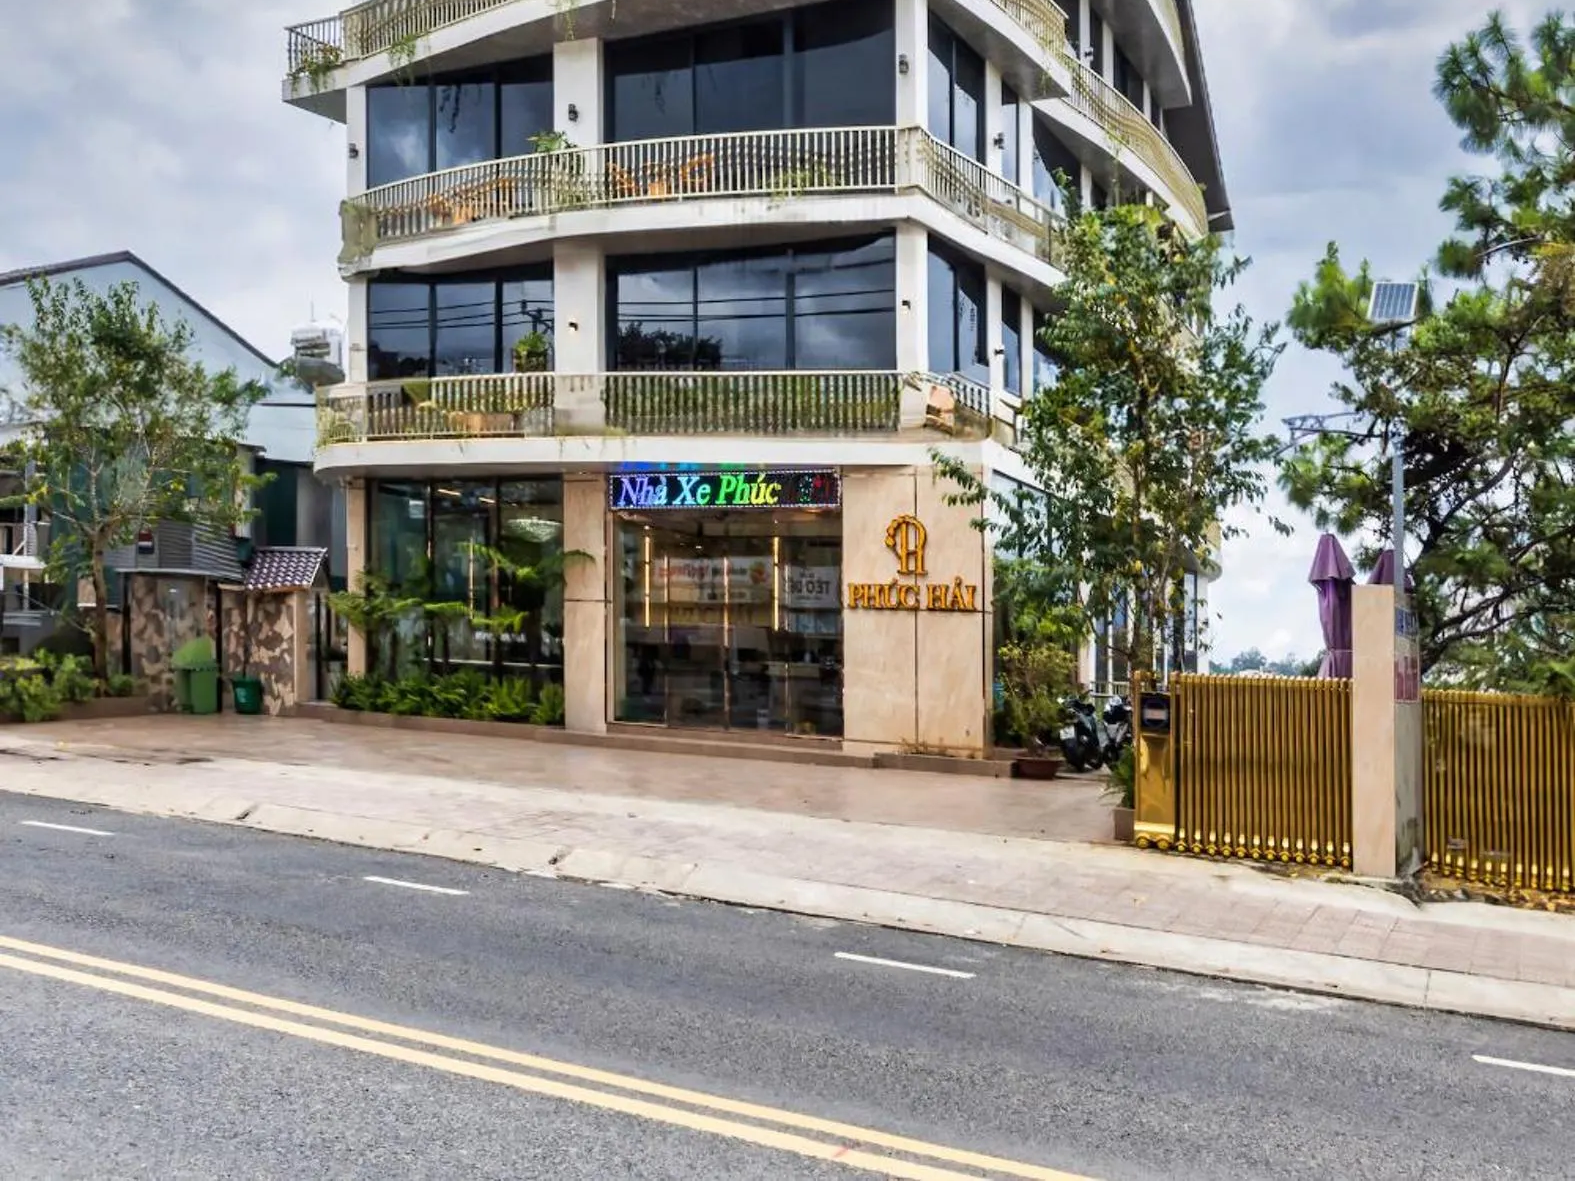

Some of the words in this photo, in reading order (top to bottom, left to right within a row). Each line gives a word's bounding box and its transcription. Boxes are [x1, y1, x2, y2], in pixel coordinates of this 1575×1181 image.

[617, 474, 668, 507] Nhà
[672, 475, 711, 506] Xe
[715, 472, 782, 506] Phúc
[926, 575, 977, 611] HẢI
